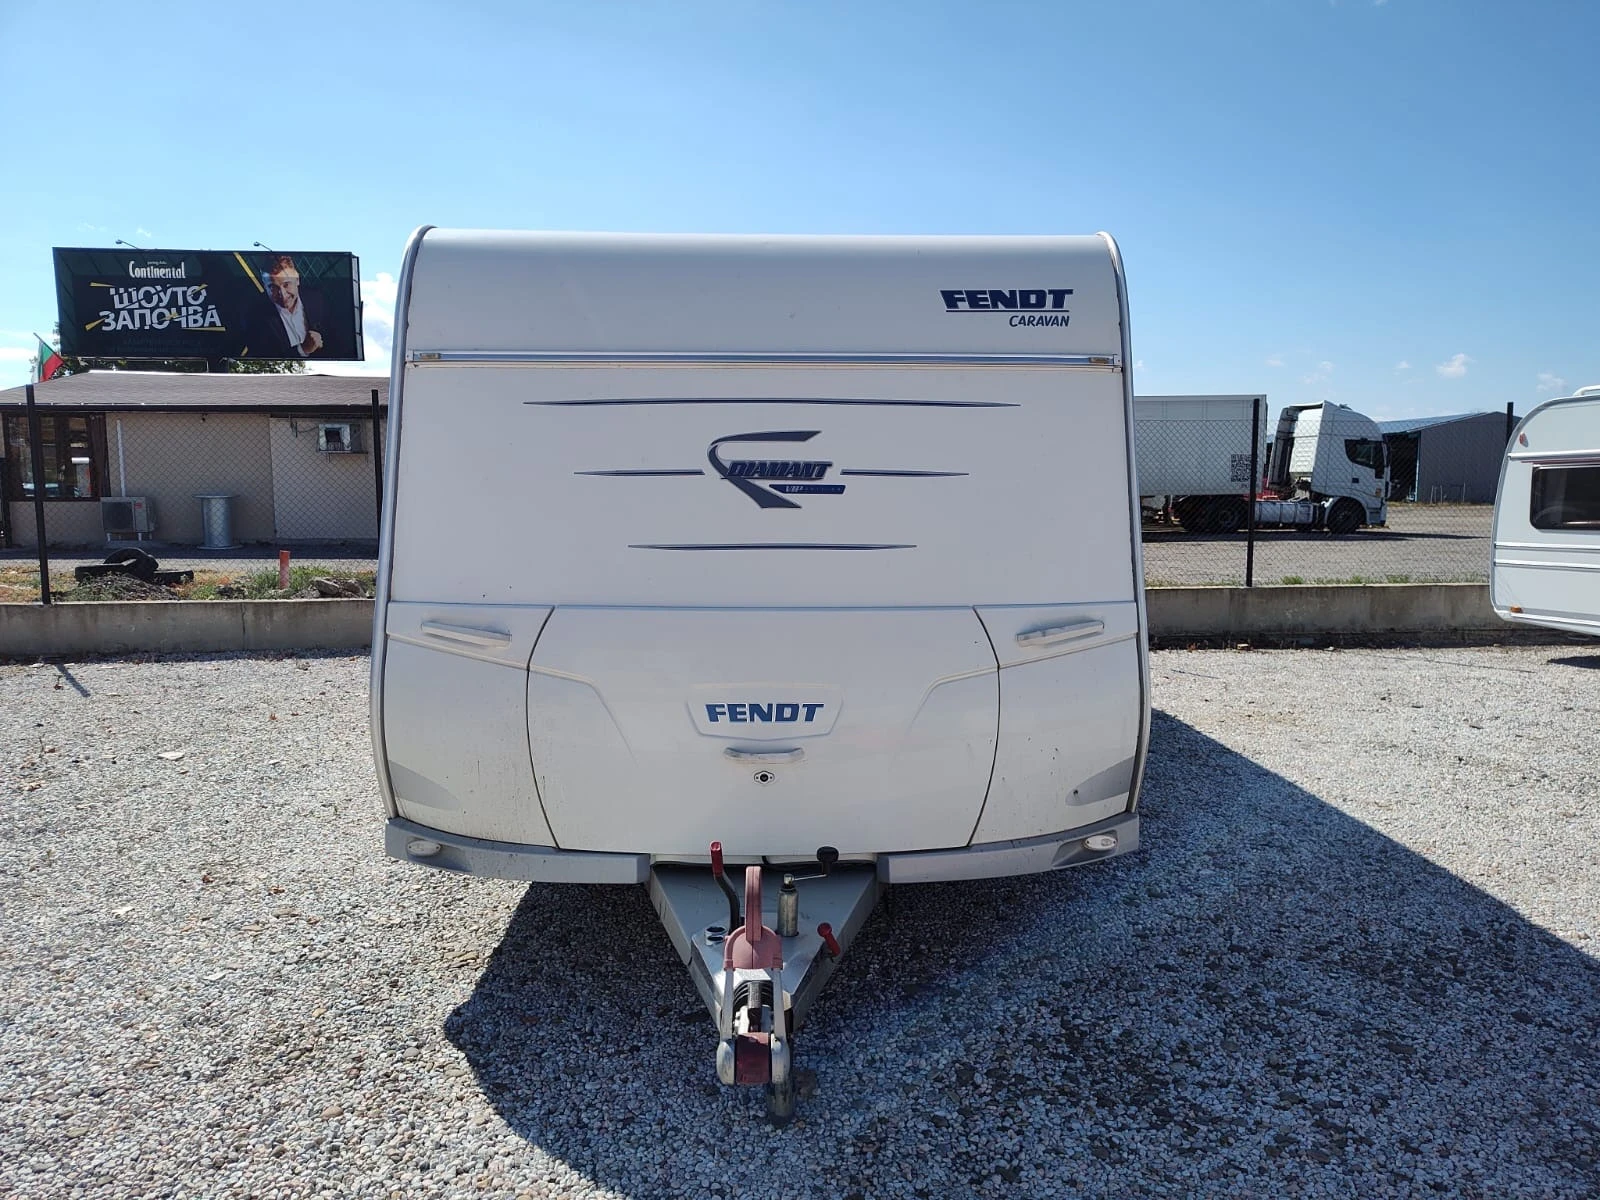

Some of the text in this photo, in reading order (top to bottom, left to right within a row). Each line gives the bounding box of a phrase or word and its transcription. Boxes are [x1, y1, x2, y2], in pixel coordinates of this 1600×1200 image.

[110, 284, 207, 309] ШОУТО
[940, 289, 1073, 309] FENDT
[99, 305, 222, 331] ЗАПОЧВА
[1009, 315, 1070, 328] CARAVAN
[727, 461, 833, 478] DIAMANT
[785, 485, 803, 493] VIP
[705, 703, 825, 723] FENDT
